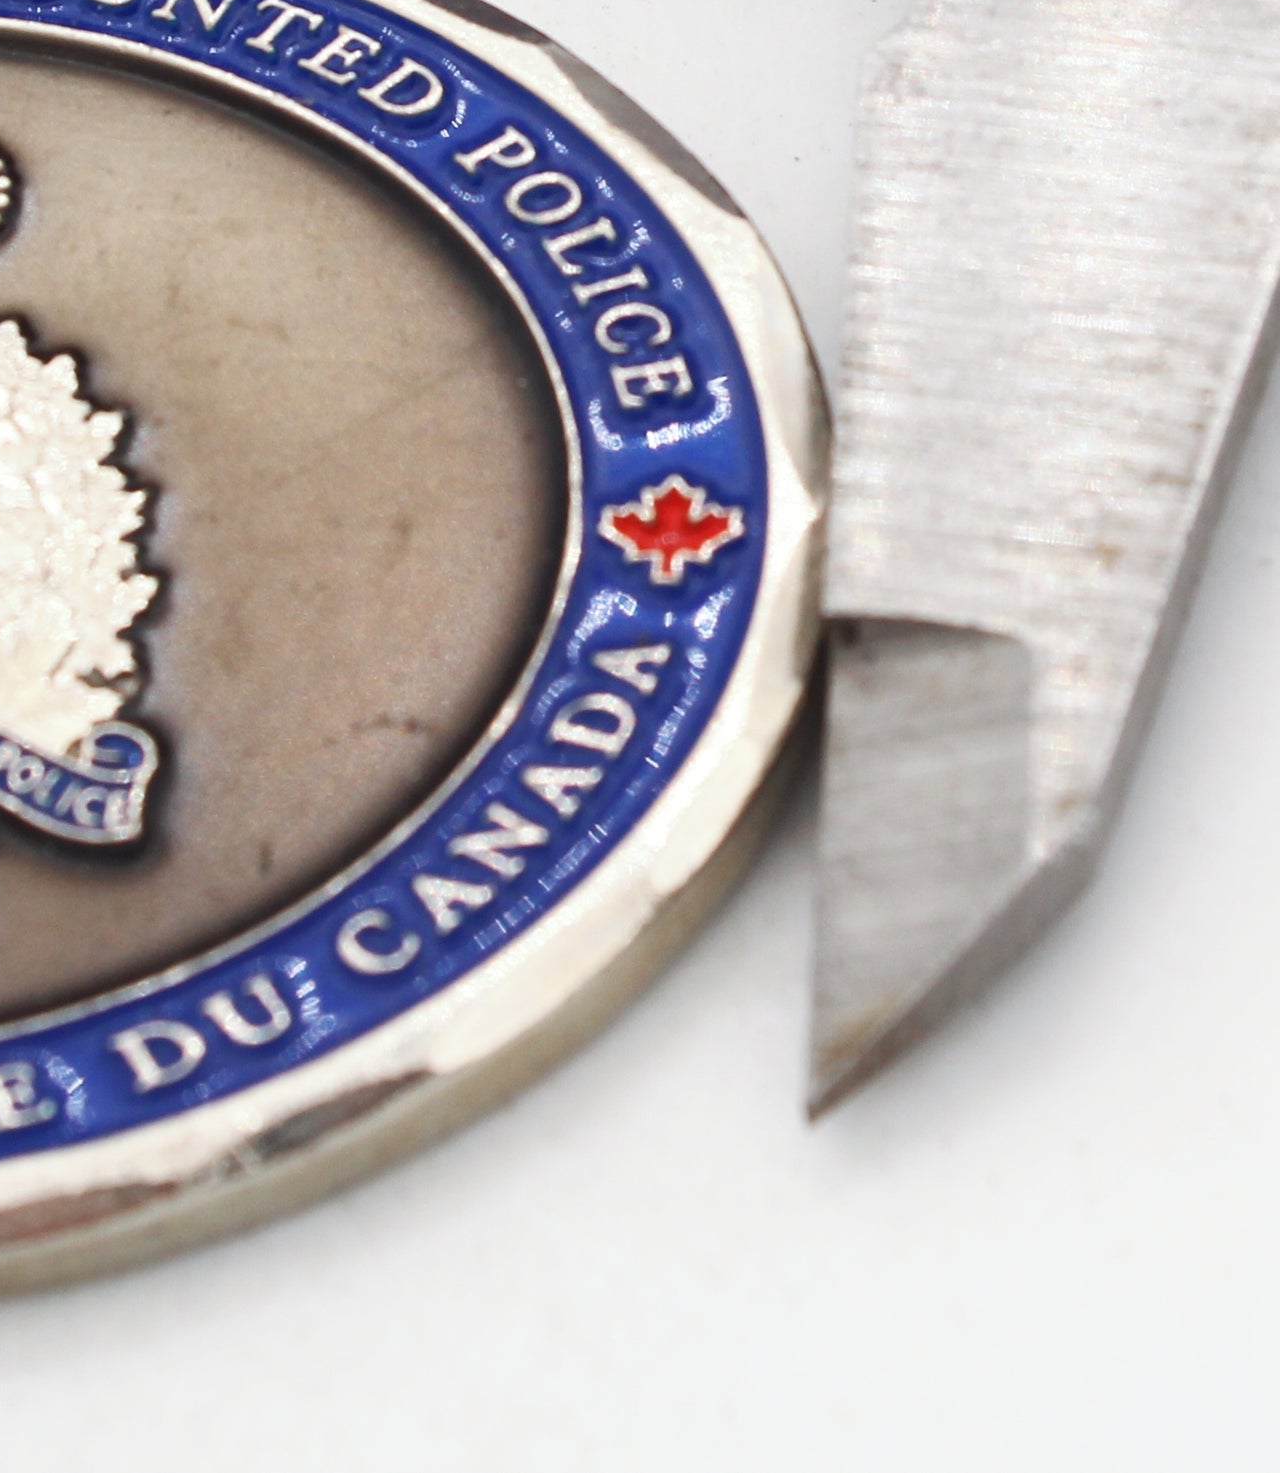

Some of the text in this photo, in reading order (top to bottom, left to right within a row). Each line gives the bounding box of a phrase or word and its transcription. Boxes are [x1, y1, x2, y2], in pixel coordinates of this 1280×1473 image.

[454, 125, 693, 408] POLICE
[111, 974, 295, 1095] DU
[336, 641, 673, 976] CANADA
